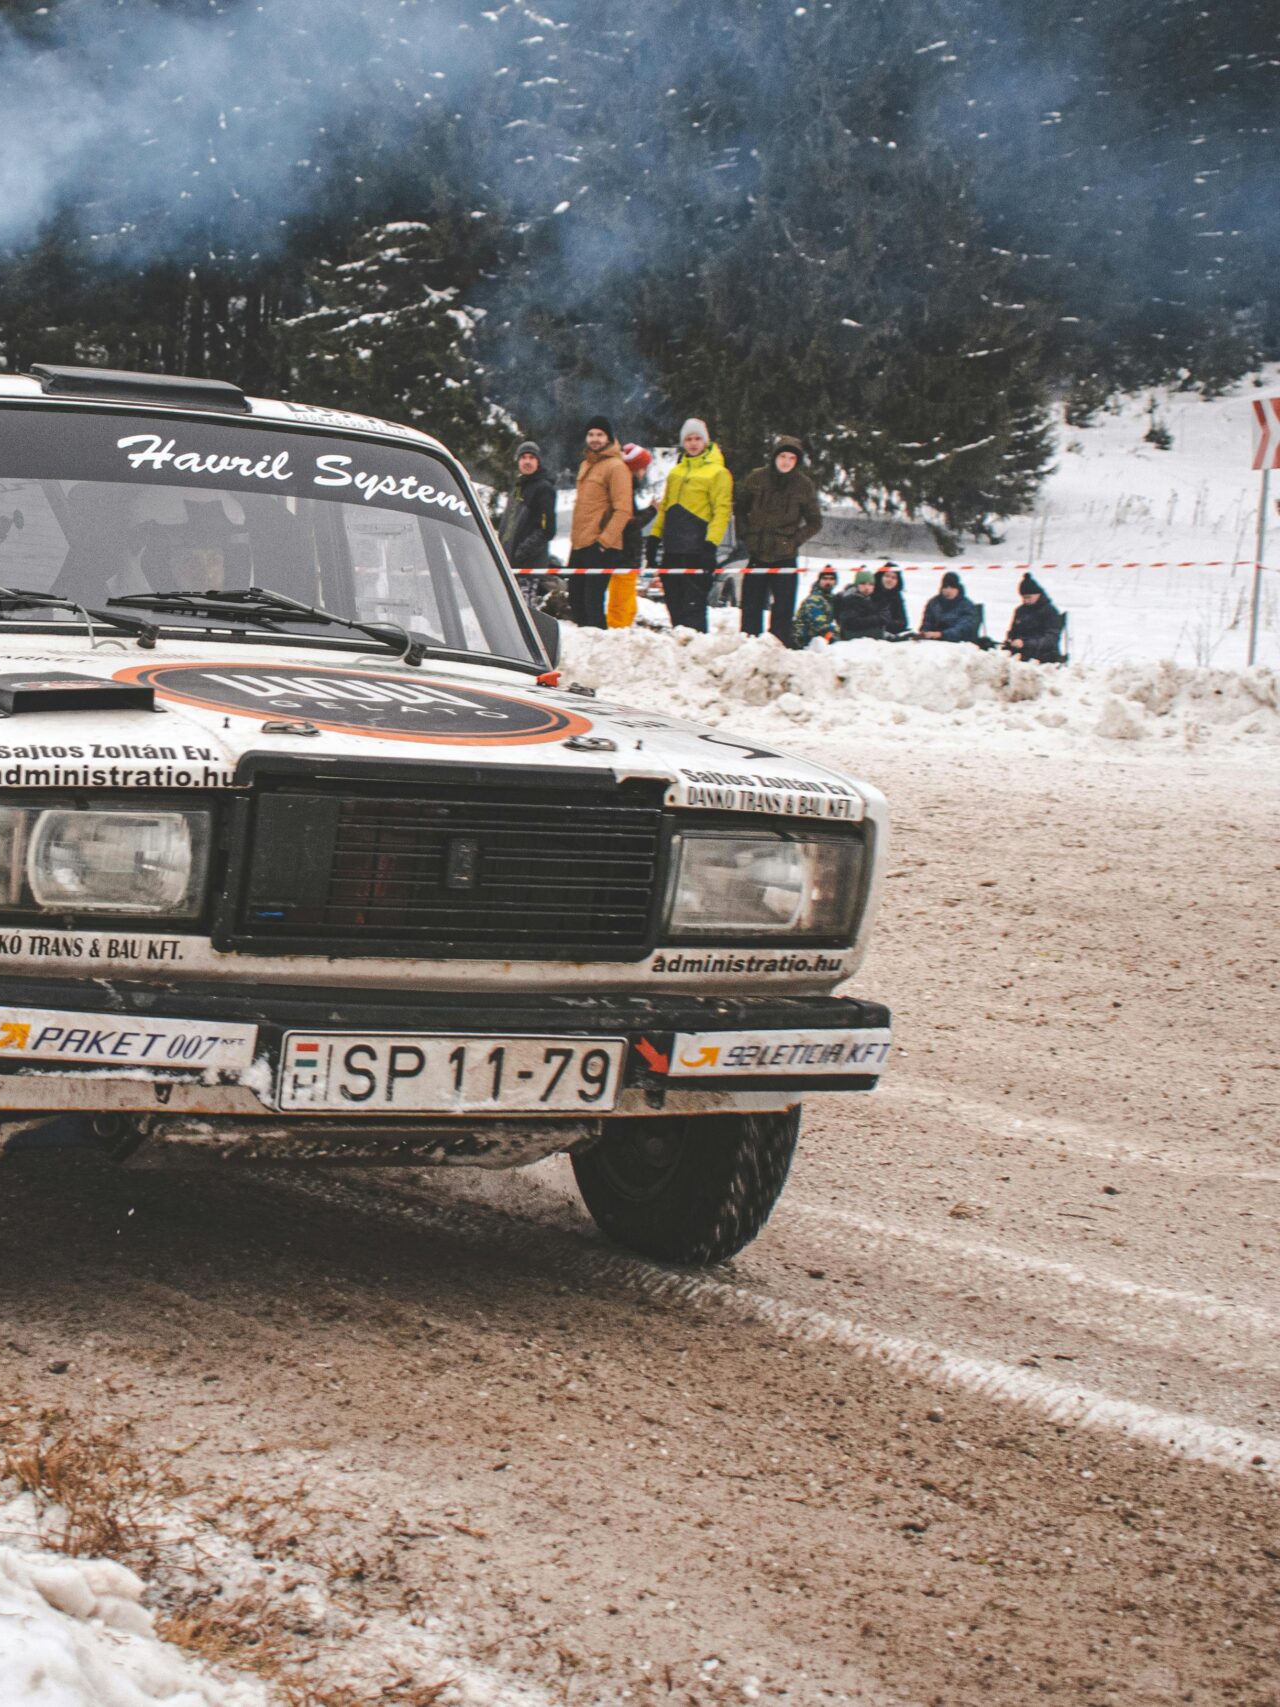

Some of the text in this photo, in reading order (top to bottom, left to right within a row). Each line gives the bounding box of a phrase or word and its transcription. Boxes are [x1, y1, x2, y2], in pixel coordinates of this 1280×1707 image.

[117, 434, 473, 517] Havril System
[268, 699, 510, 720] GELATO
[90, 742, 178, 761] Zoltán
[181, 743, 220, 762] Ev.
[680, 768, 755, 788] Sajtos
[754, 772, 821, 794] Zoltán
[738, 790, 783, 813] TRANS
[797, 796, 821, 817] BAU
[29, 934, 85, 958] TRANS
[89, 937, 102, 958] &
[106, 936, 143, 960] BAU
[146, 937, 185, 961] KFT.
[651, 953, 843, 973] administratio.hu
[30, 1026, 167, 1058] PAKET
[165, 1034, 220, 1061] 007
[339, 1044, 612, 1103] SP 11-79
